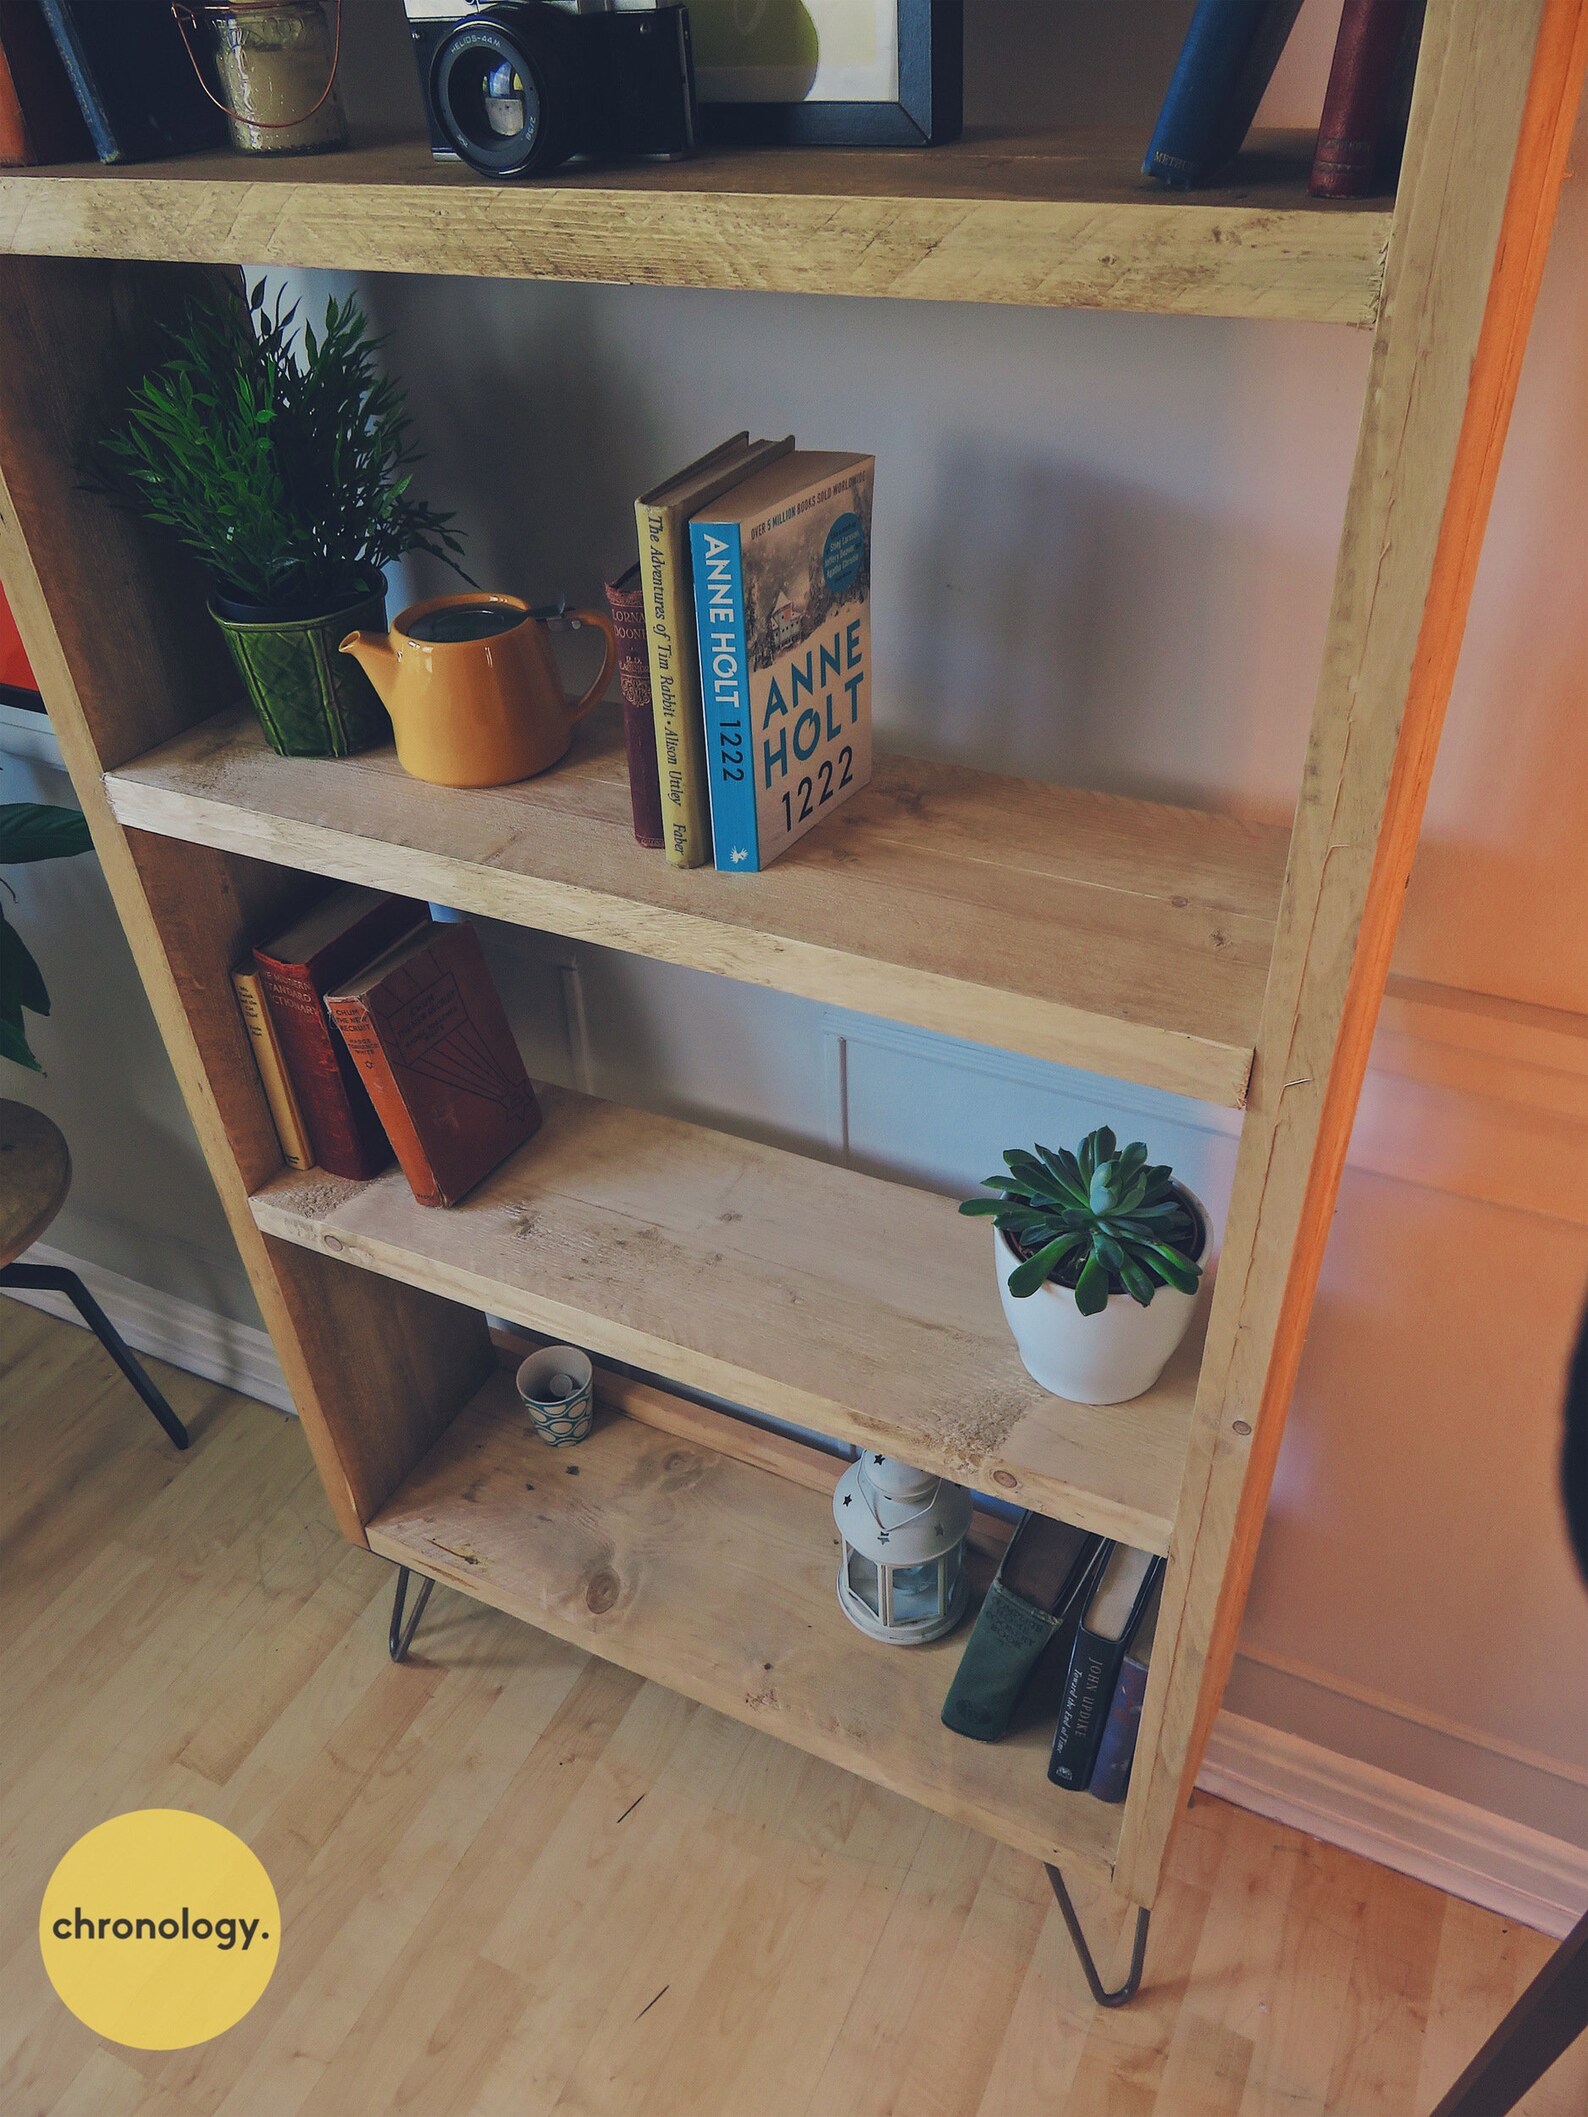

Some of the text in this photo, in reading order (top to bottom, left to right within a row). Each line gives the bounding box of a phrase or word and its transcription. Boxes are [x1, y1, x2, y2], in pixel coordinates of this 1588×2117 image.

[750, 523, 766, 540] OVER
[772, 507, 796, 528] MILLION
[797, 496, 816, 515] BOOKS
[817, 487, 832, 503] SOLD
[832, 470, 866, 495] WORLDWIDE
[648, 516, 676, 717] The Adventures of Tim Rabbit
[703, 534, 745, 782] ANNE HOLT 1222
[762, 618, 863, 730] ANNE
[664, 726, 682, 807] Alison Uttley
[764, 671, 864, 790] HOLT
[782, 745, 853, 833] 1222
[673, 824, 687, 855] Faber
[267, 982, 312, 1004] TANDARD
[1063, 1711, 1073, 1728] End
[1066, 1697, 1076, 1710] the
[1069, 1669, 1083, 1698] Toward
[1075, 1657, 1103, 1736] JOHN UPDIKE
[1056, 1737, 1068, 1754] Time
